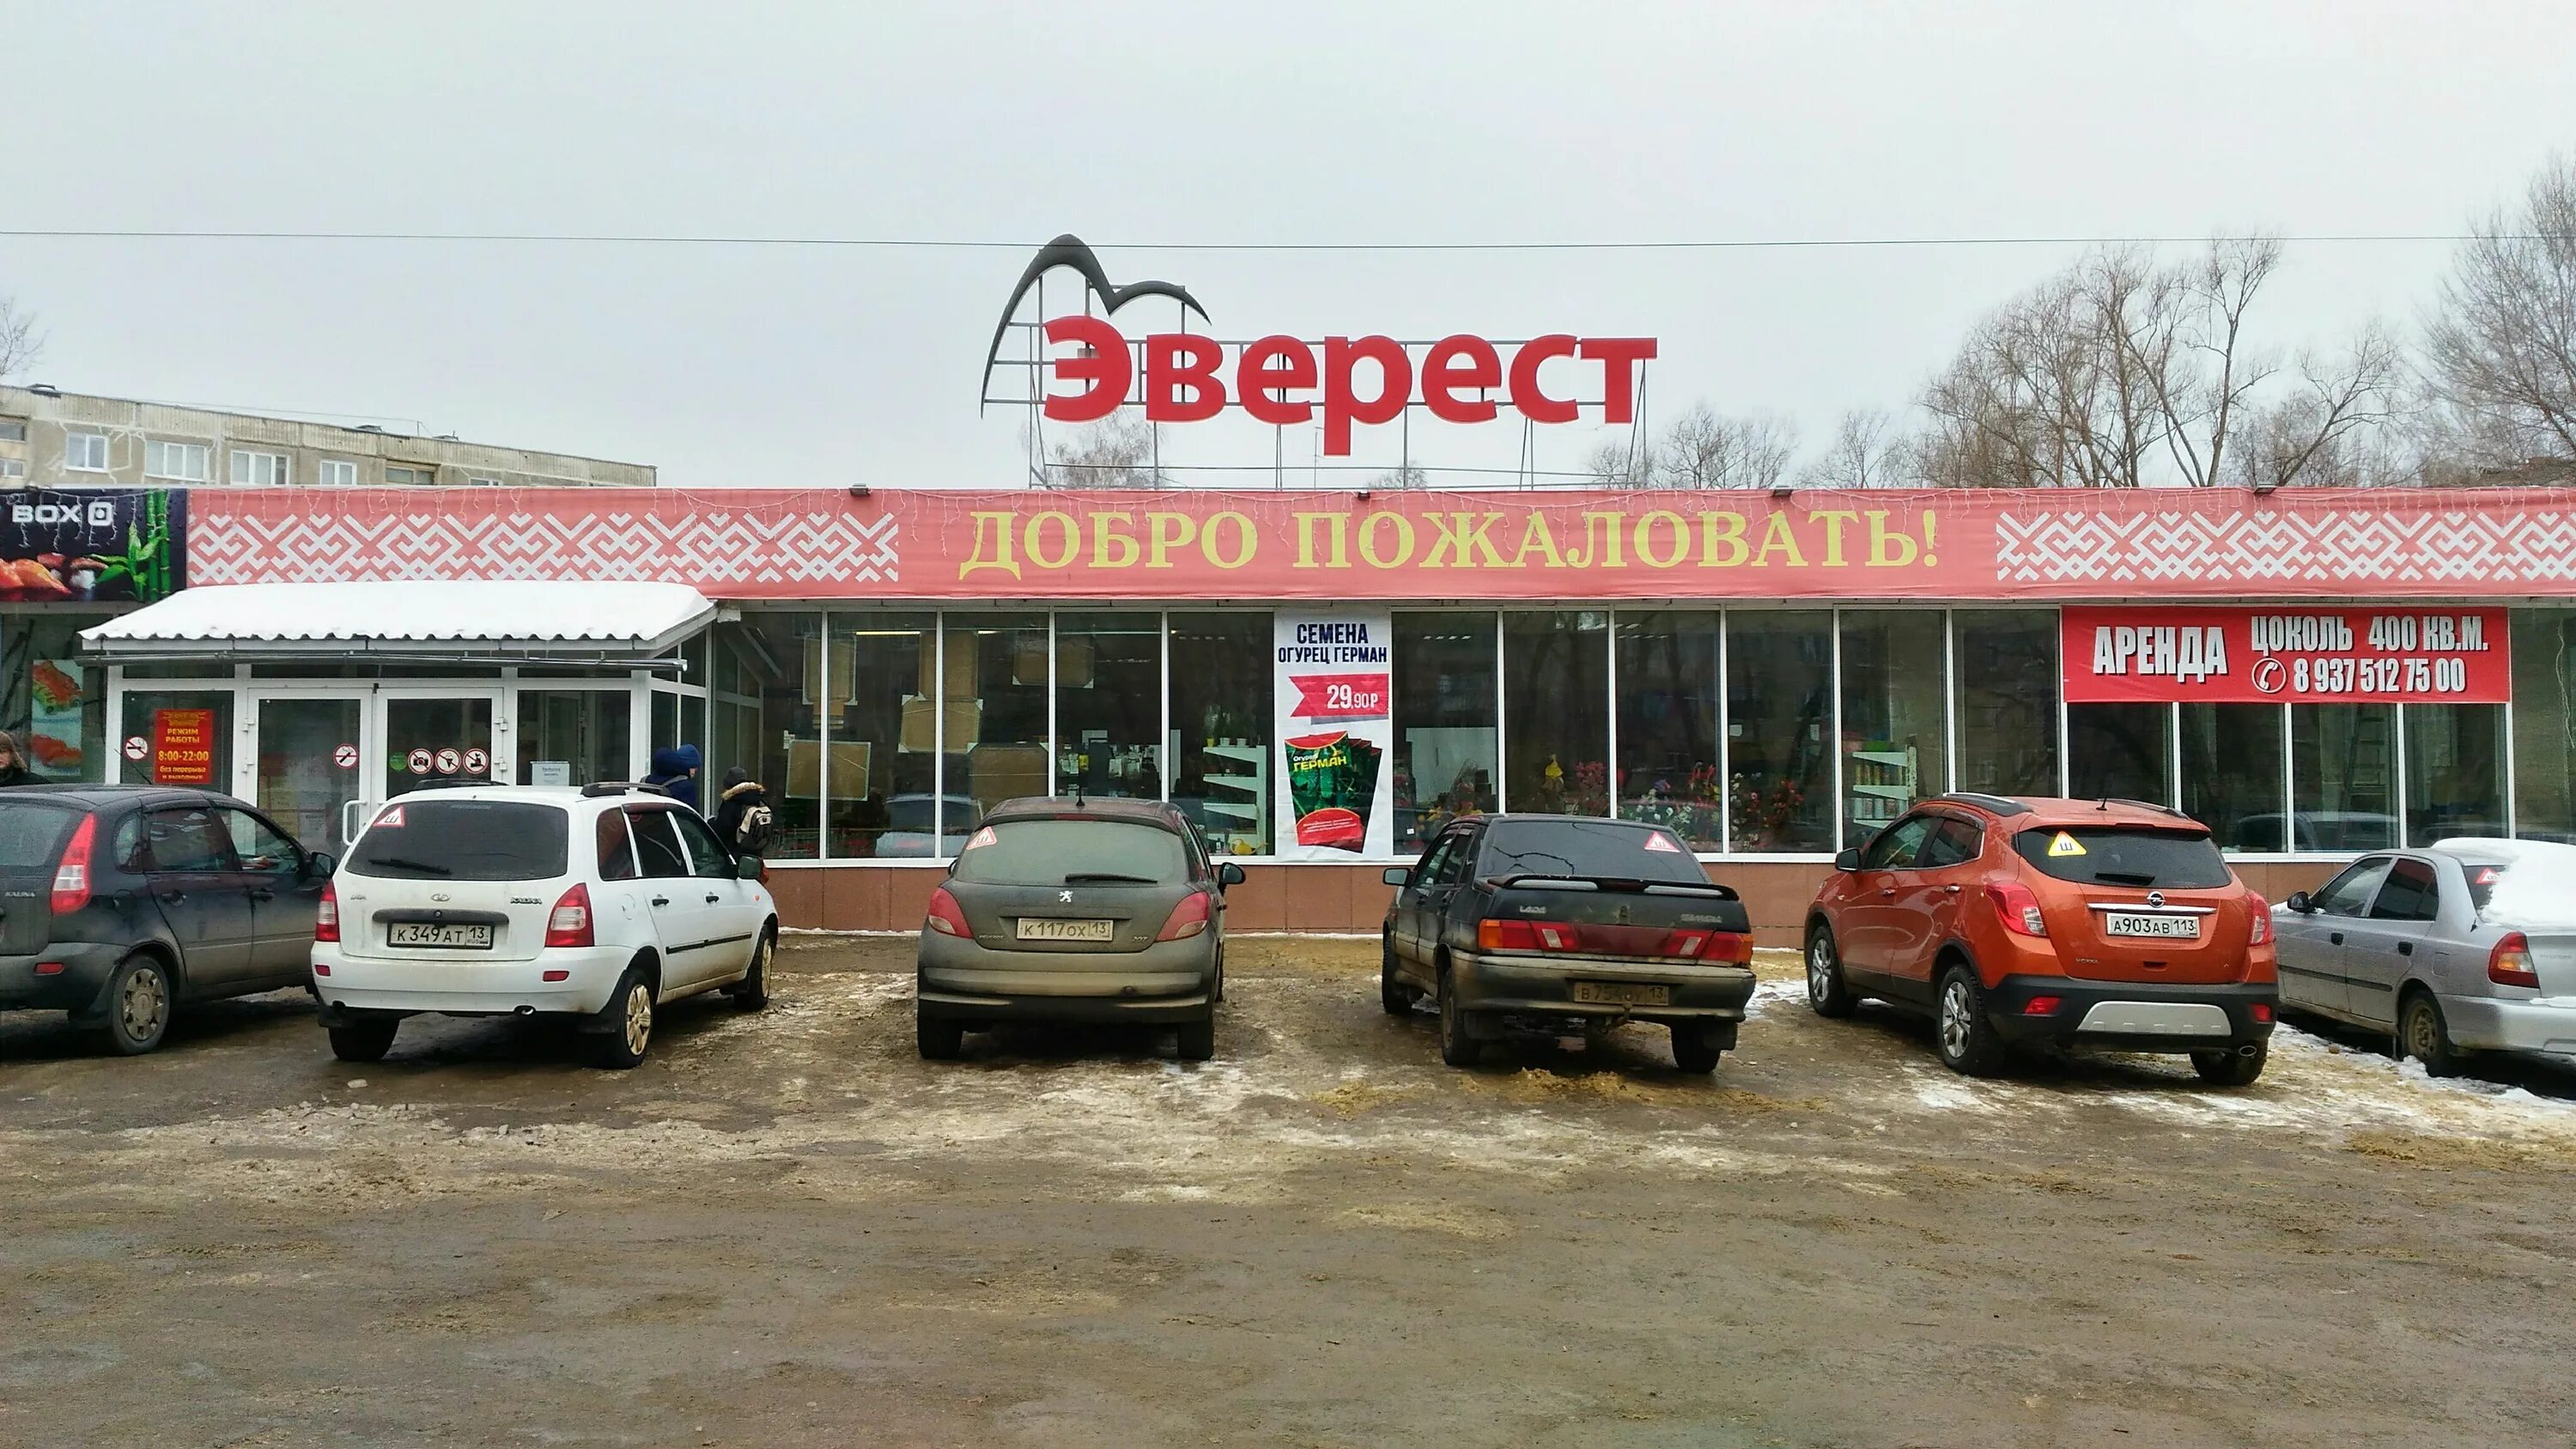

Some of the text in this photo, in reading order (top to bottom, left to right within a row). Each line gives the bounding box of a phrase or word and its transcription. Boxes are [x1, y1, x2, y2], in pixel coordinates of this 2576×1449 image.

[1042, 315, 1657, 457] Эверест
[12, 504, 82, 524] BOX
[958, 509, 1938, 580] ДОБРО ПОЖАЛОВАТЬ!
[1297, 623, 1369, 644] СЕМЕНА
[2251, 615, 2489, 657] ЦОКОЛЬ 400 КВ.М.
[1278, 646, 1388, 664] ОГУРЕЦ ГЕРМАН
[2093, 627, 2227, 682] АРЕНДА
[2293, 658, 2466, 693] 8 937 512 75 00
[158, 750, 210, 761] 8:00-22:00
[1293, 755, 1347, 773] ГЕРМАН
[2173, 919, 2195, 931] 113
